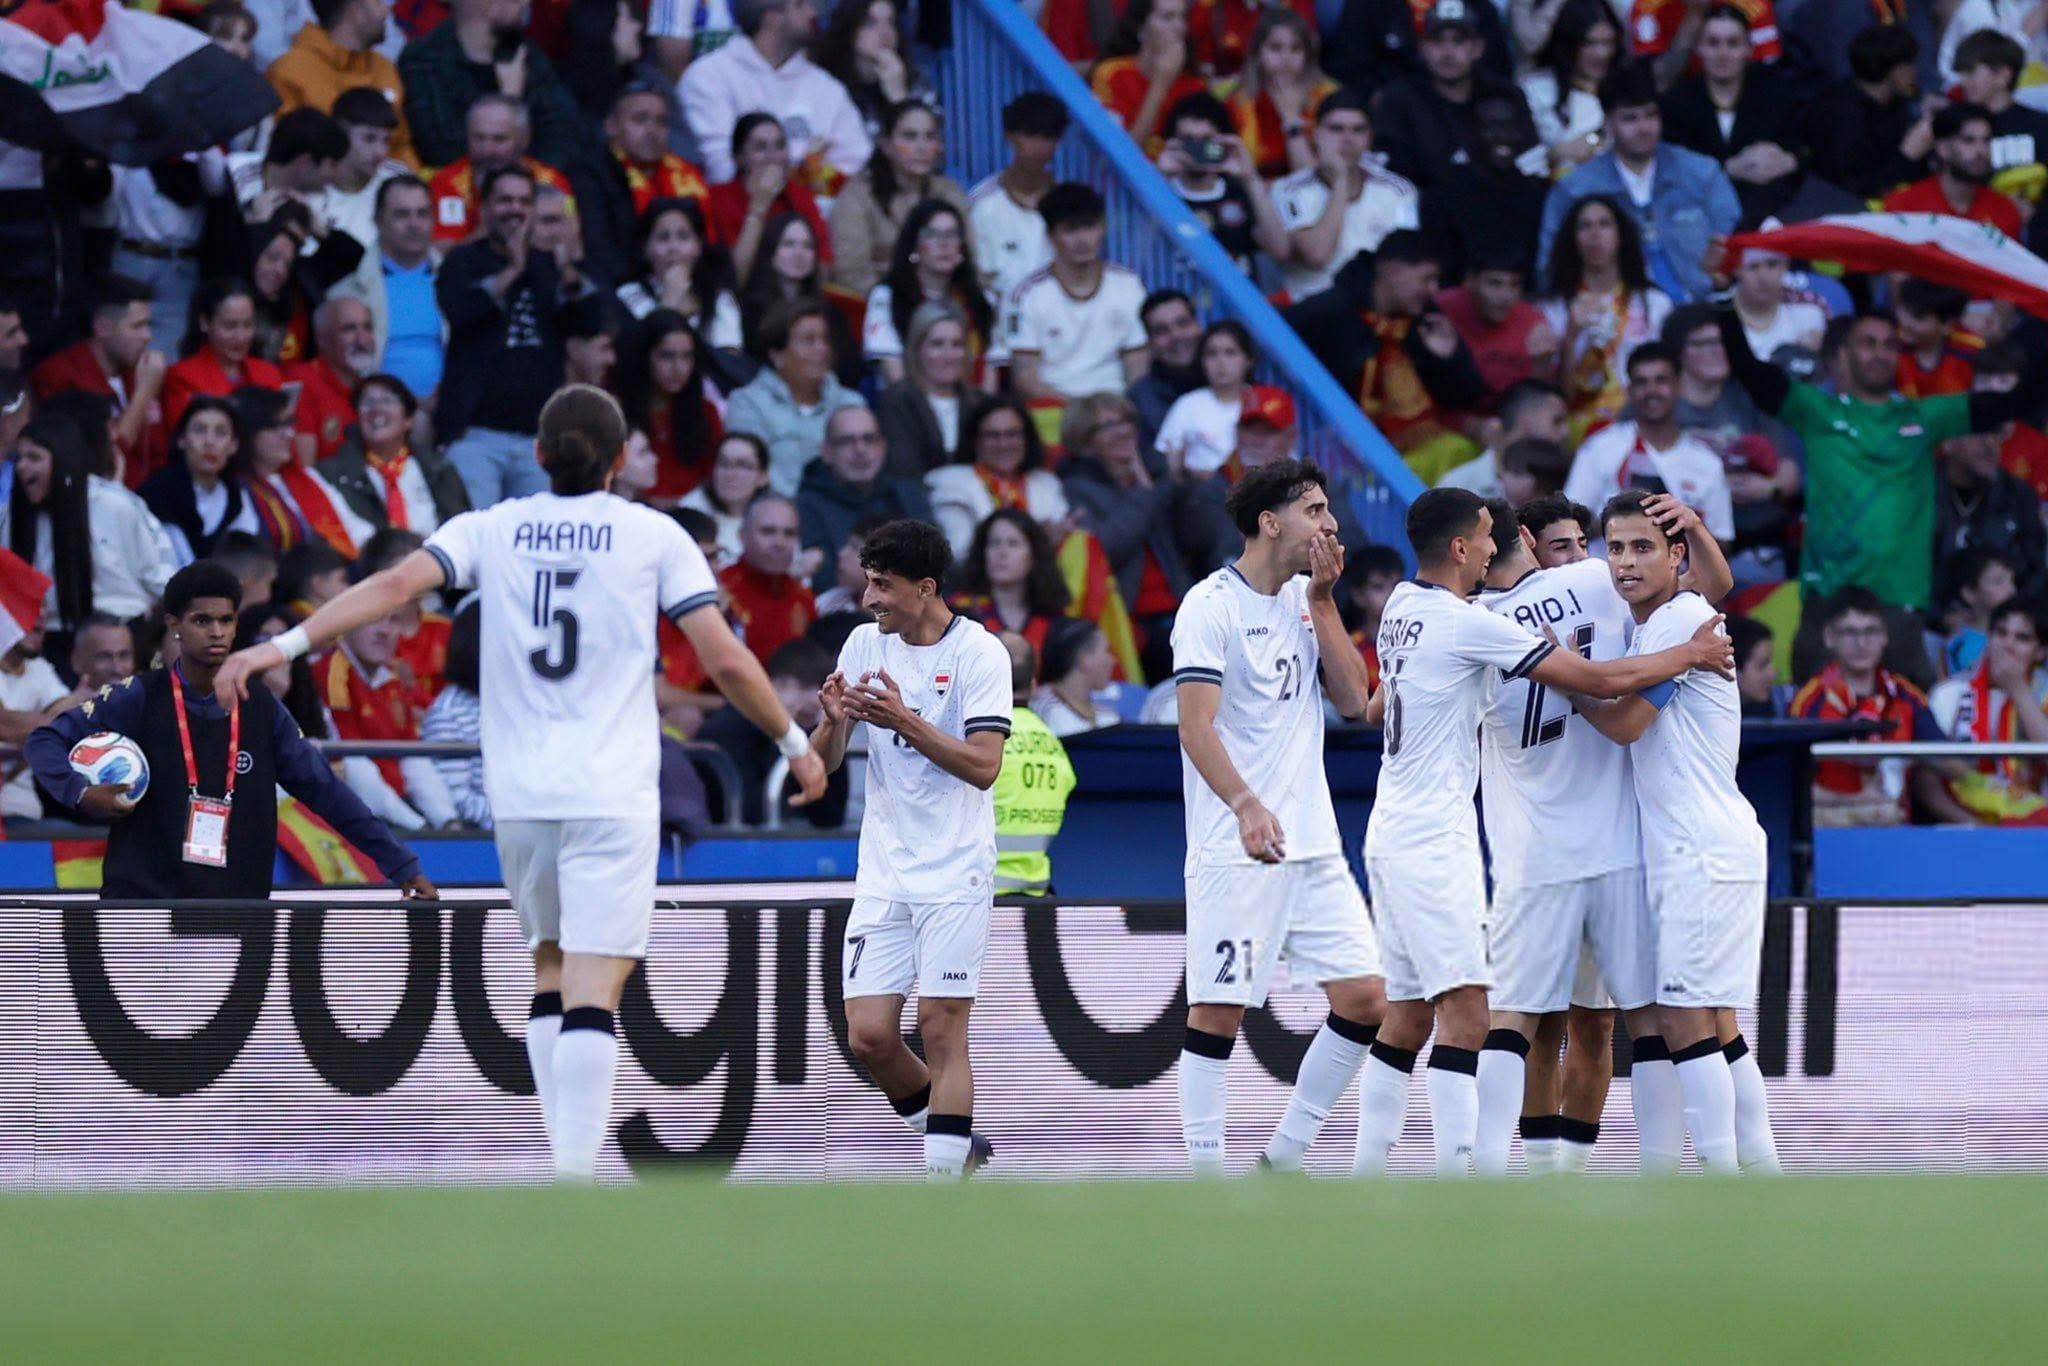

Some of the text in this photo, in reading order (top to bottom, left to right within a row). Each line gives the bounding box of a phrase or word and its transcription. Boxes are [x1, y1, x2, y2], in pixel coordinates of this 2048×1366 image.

[514, 521, 612, 552] AKAM
[1503, 588, 1583, 628] AID.I
[1246, 626, 1269, 637] JAKO
[1022, 762, 1057, 791] 078
[942, 972, 968, 981] JAKO
[1214, 939, 1252, 984] 21
